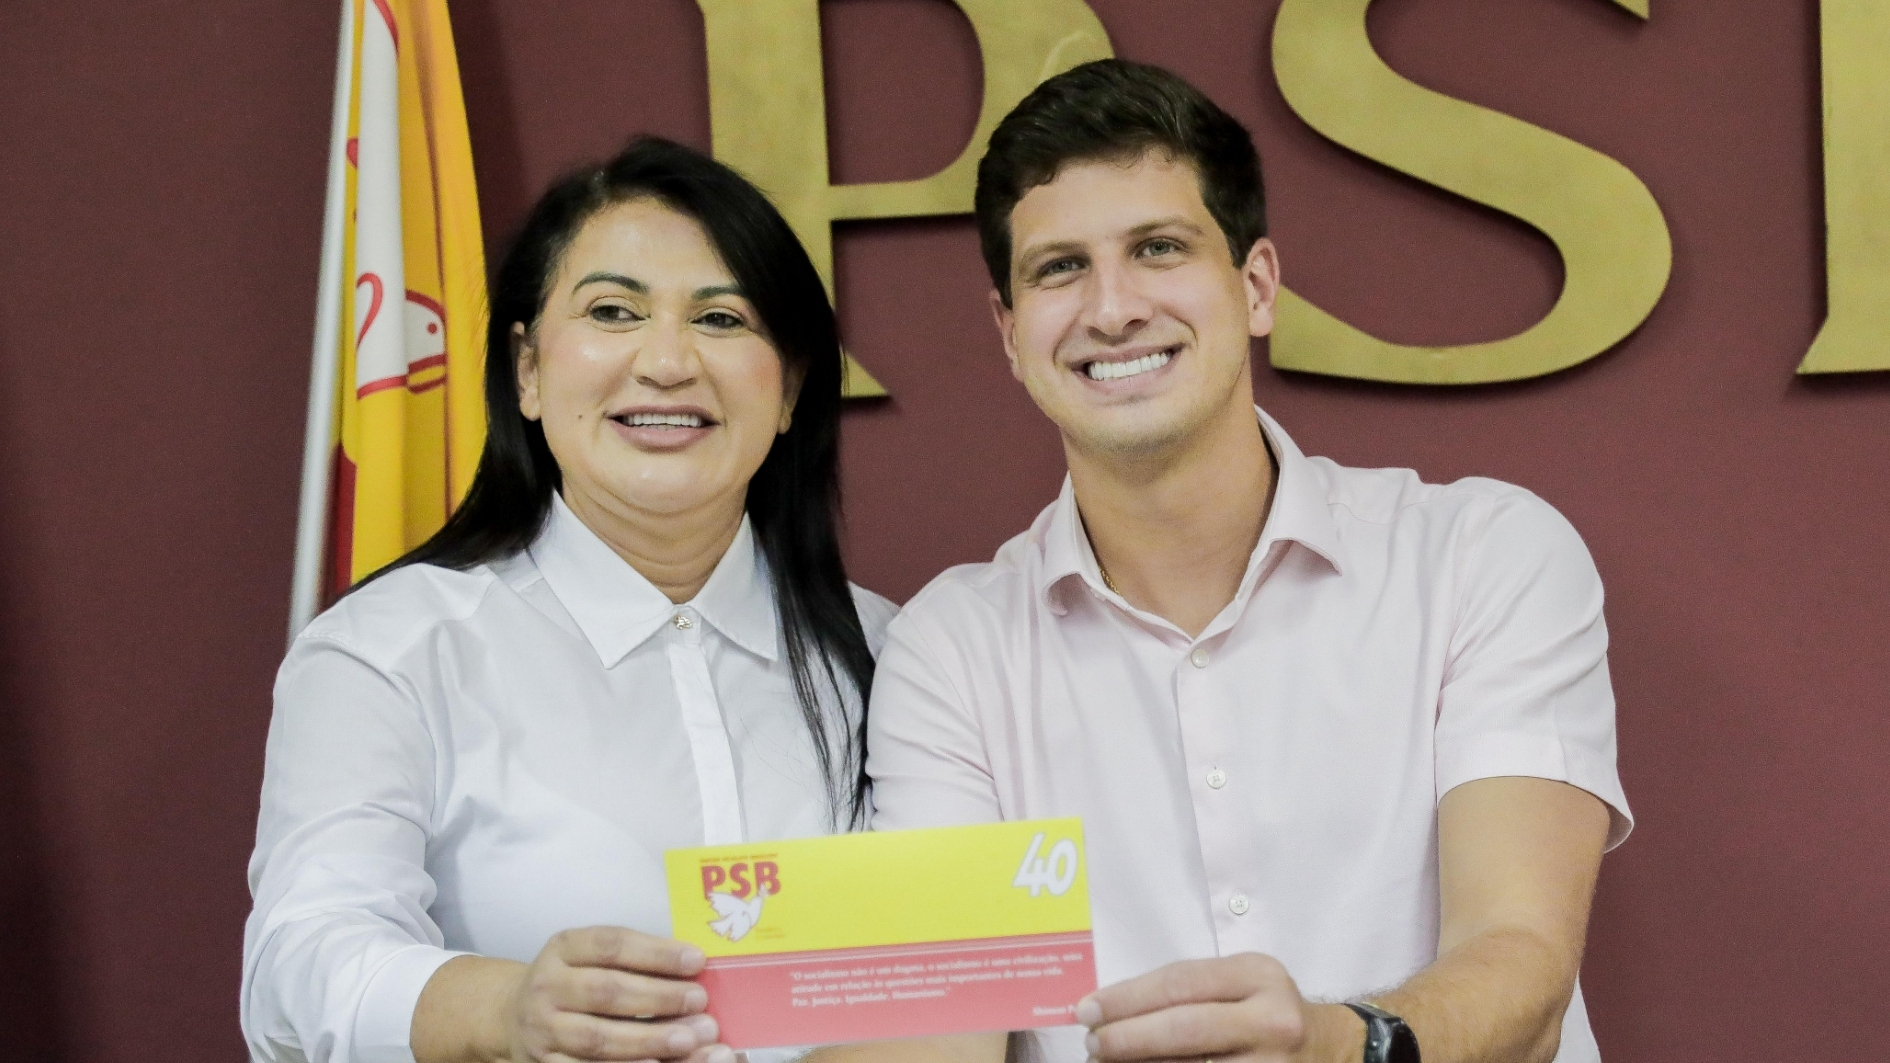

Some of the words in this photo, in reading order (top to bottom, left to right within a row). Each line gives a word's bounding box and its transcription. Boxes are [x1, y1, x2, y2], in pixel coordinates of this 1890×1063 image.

[695, 0, 1890, 398] PS
[701, 862, 781, 901] PSB
[1012, 831, 1078, 897] 40
